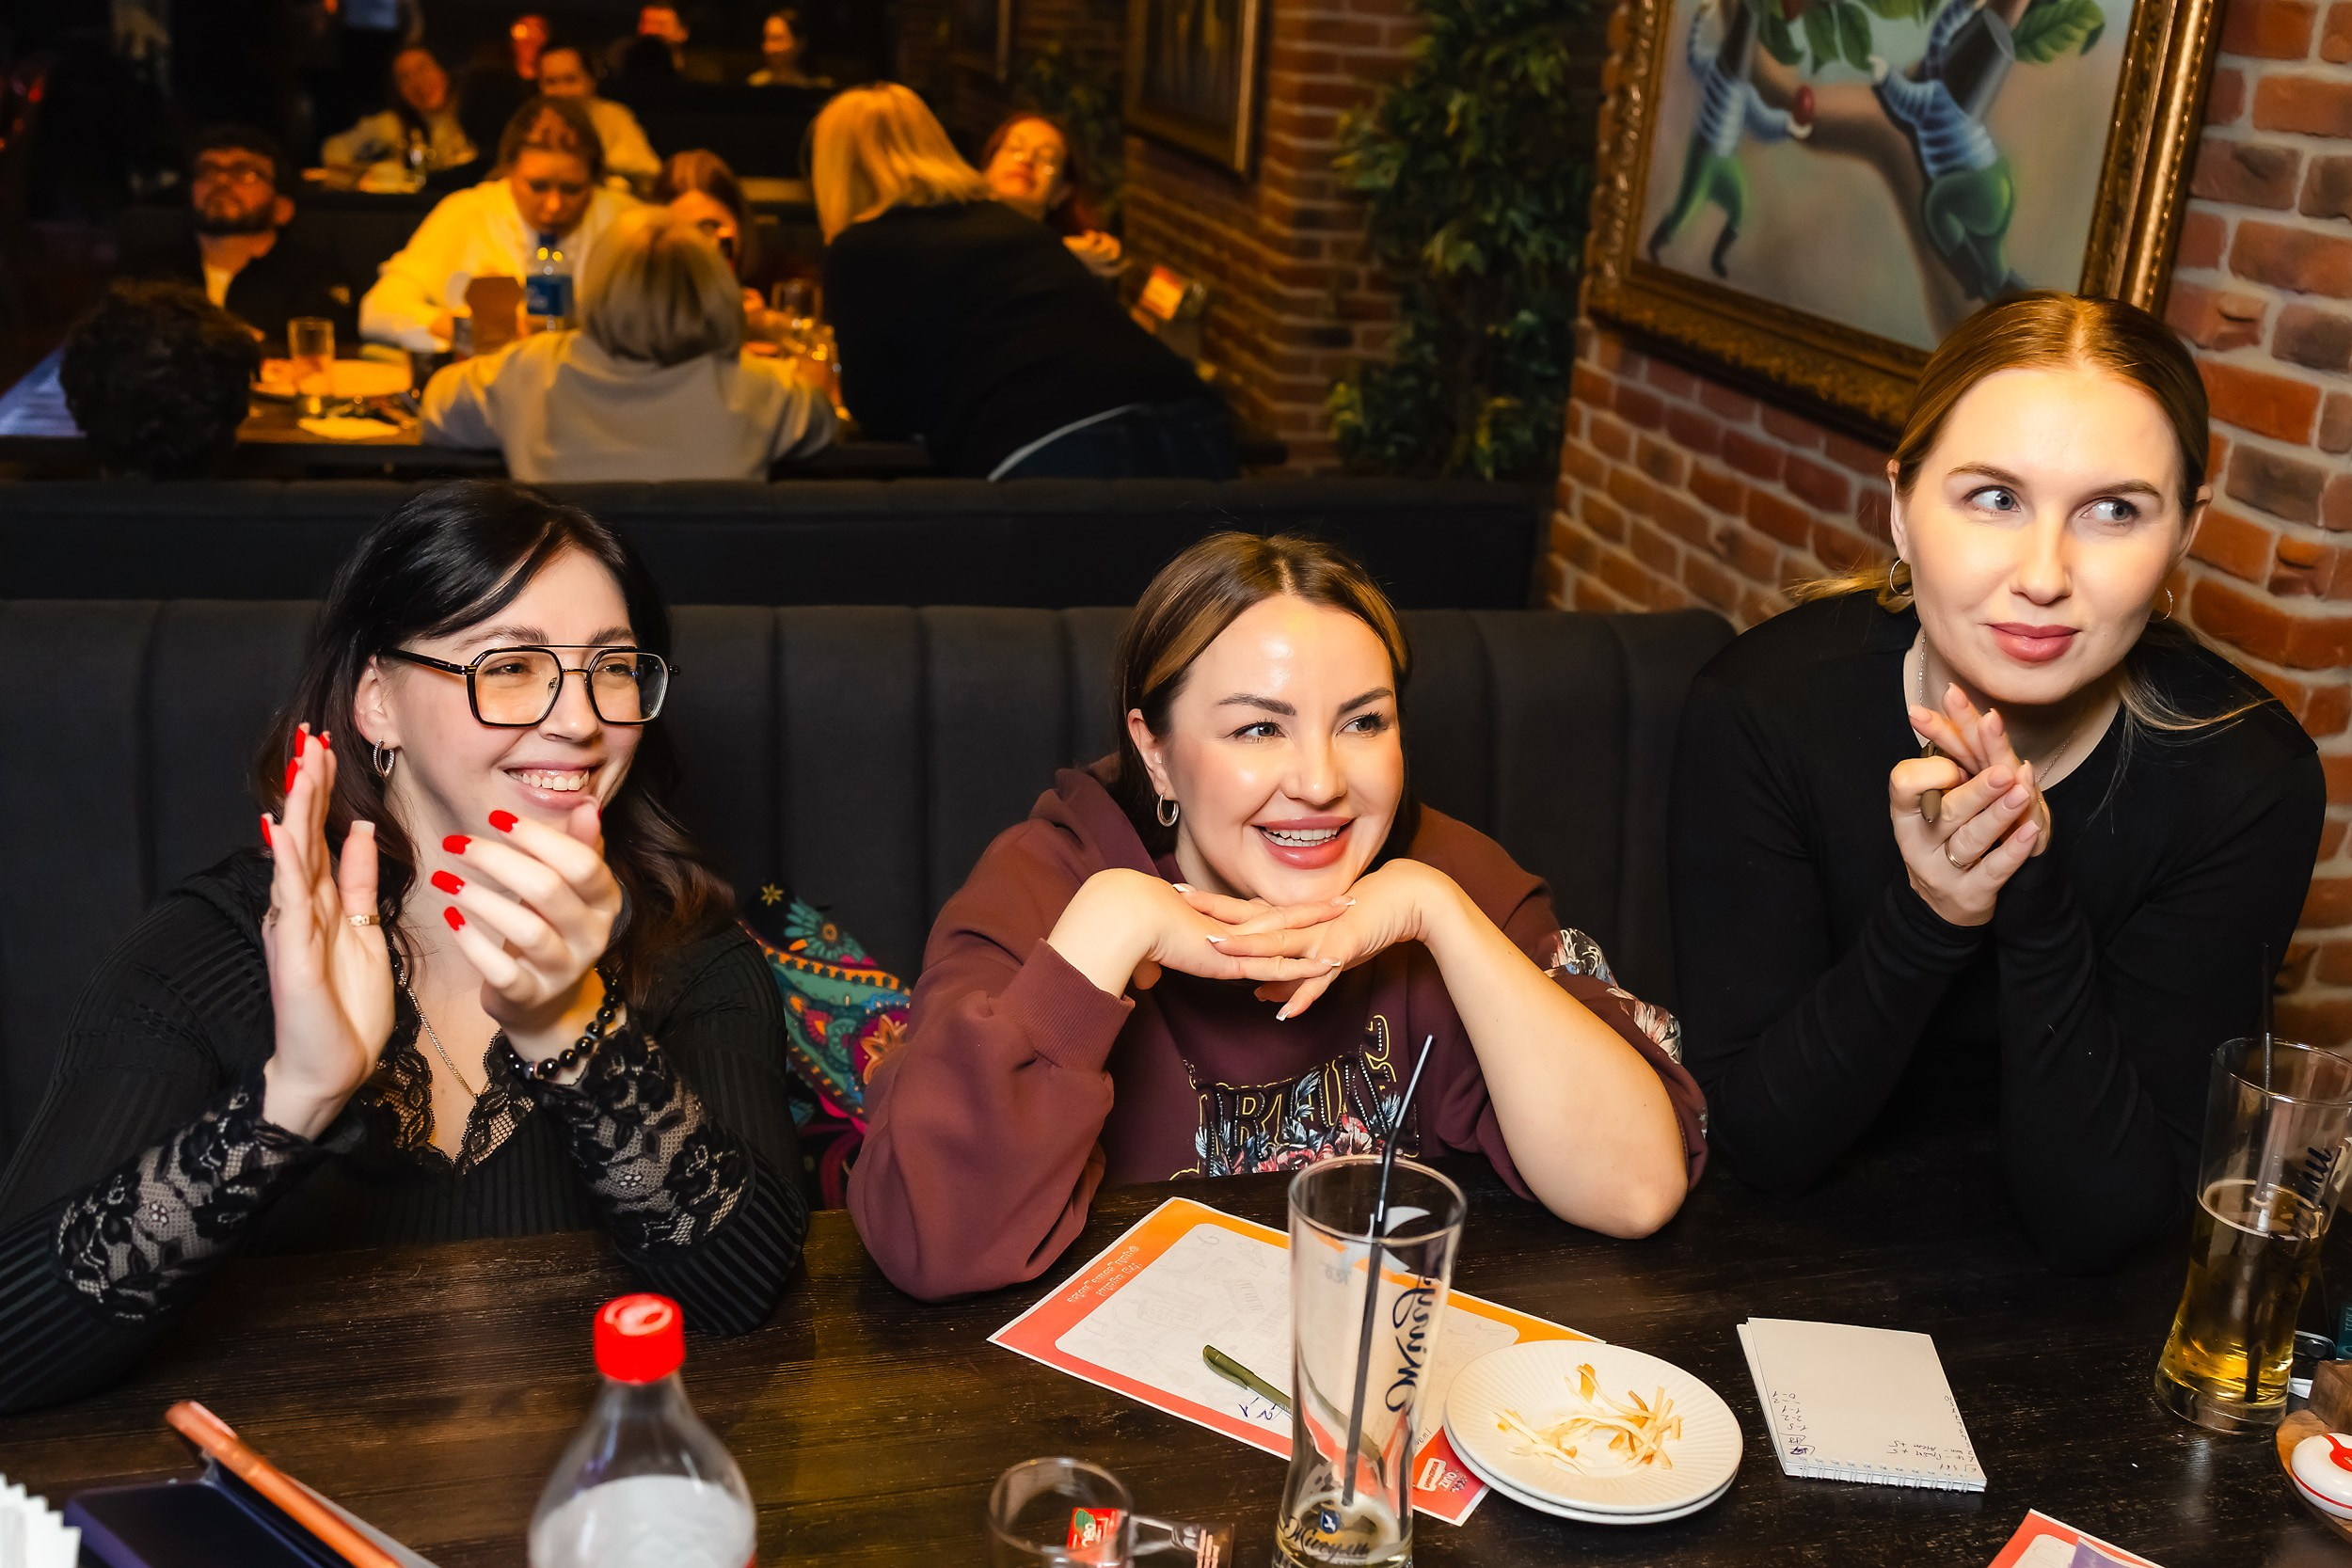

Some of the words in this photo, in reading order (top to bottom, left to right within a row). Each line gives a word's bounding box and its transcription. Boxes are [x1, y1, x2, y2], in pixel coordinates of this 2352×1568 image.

[1120, 1262, 1143, 1275] Try
[1095, 1275, 1125, 1297] again!
[1438, 1471, 1457, 1489] QUIZ
